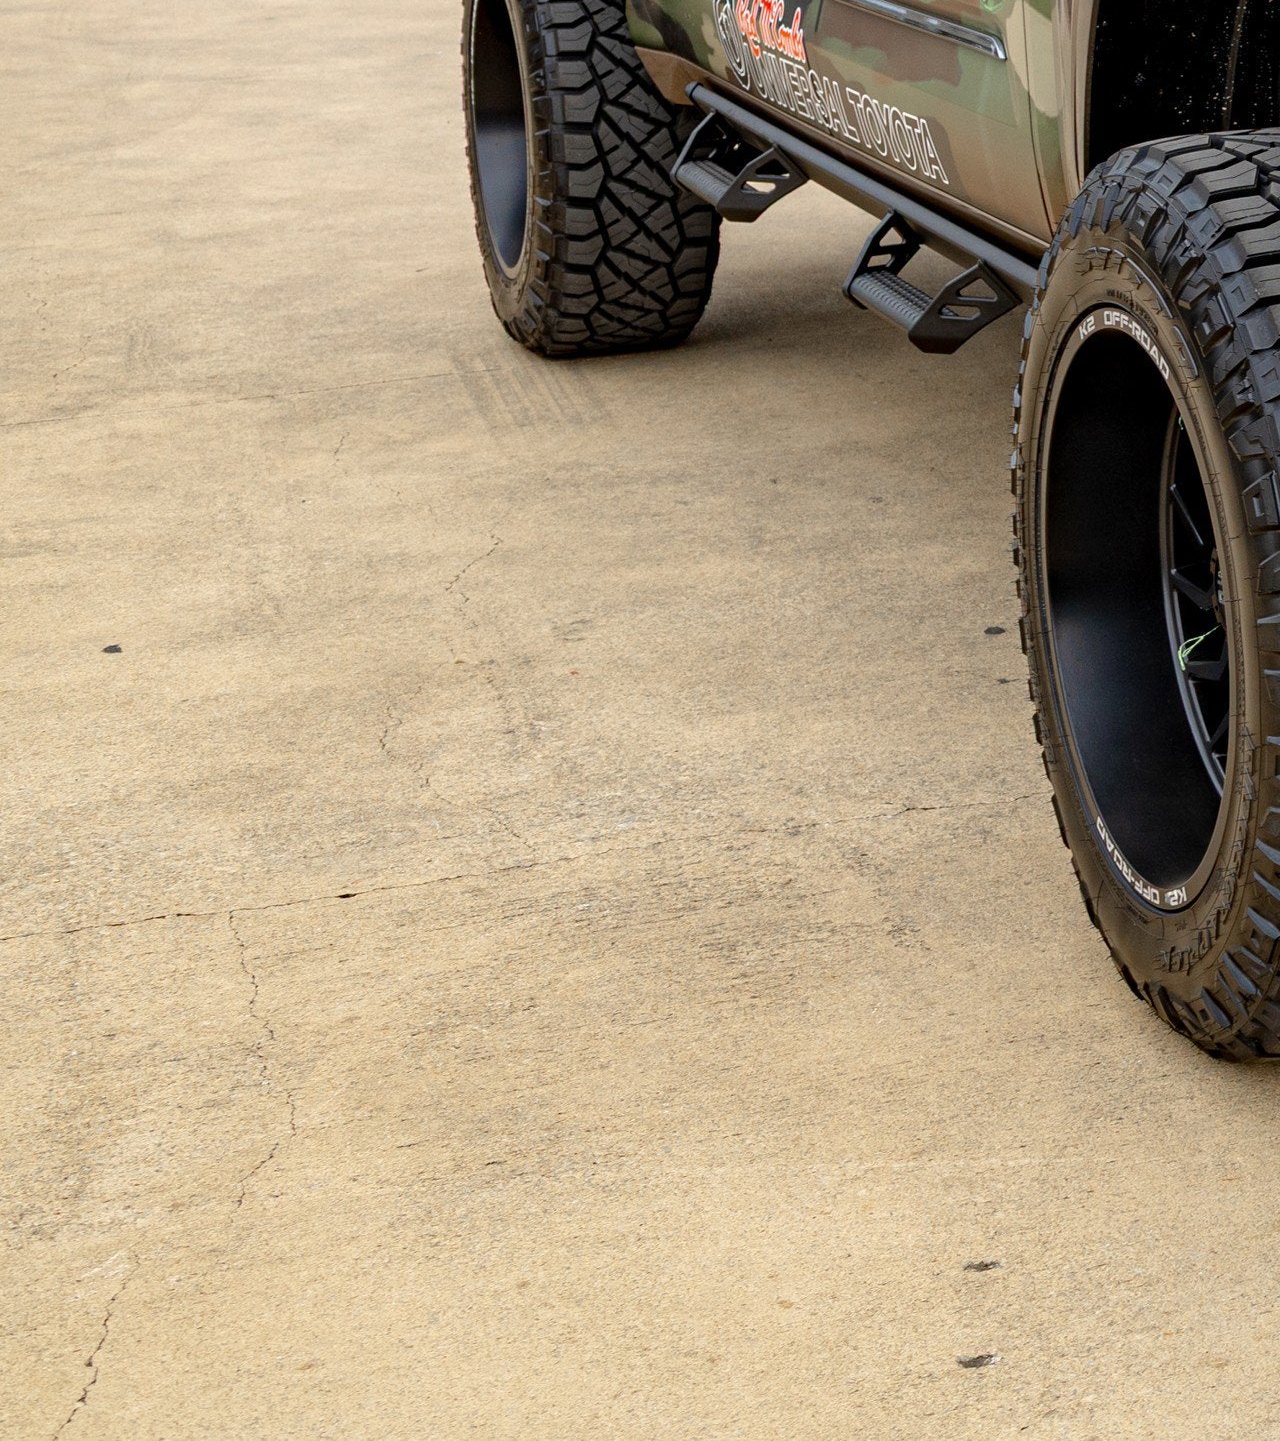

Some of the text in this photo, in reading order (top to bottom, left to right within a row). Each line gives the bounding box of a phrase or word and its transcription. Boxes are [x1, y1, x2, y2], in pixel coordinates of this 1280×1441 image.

[744, 42, 950, 185] UNIVERSAL TOYOTA
[1079, 315, 1096, 340] K2
[1103, 310, 1170, 380] OFF-ROAD
[1096, 815, 1161, 906] OFF-ROAD
